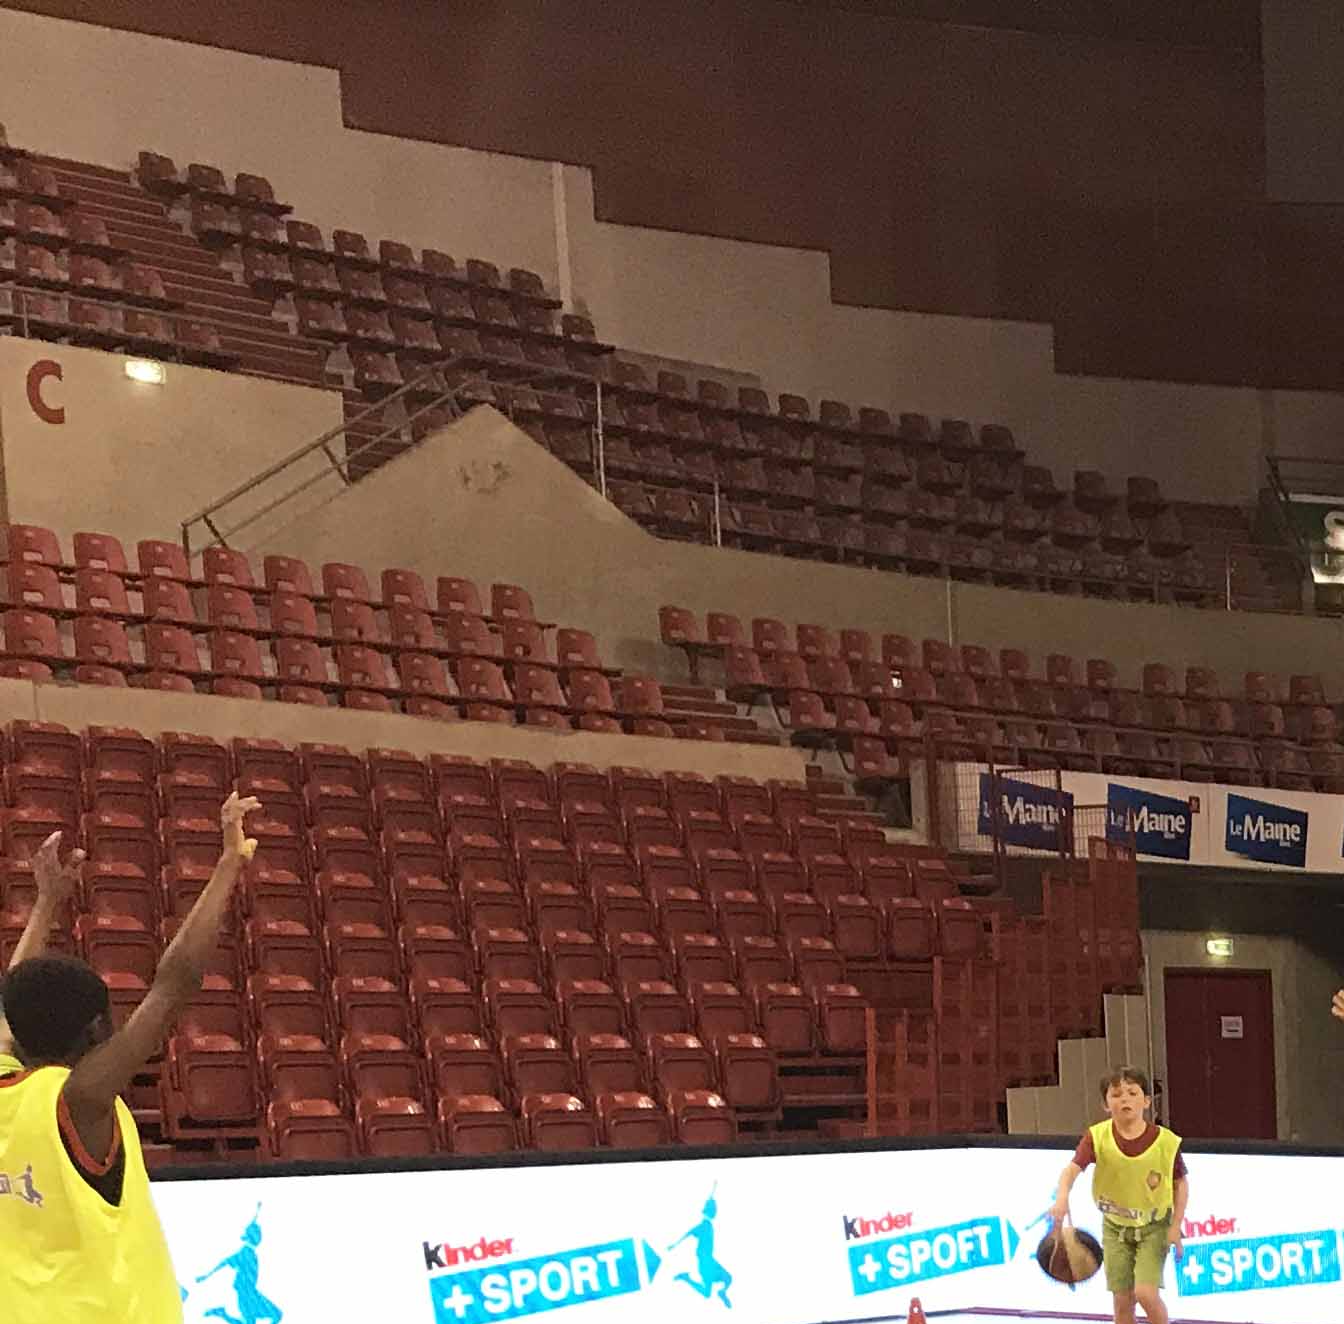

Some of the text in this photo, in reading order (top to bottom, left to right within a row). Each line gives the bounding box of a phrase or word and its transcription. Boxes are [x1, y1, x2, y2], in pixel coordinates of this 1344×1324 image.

[26, 359, 65, 425] C
[1229, 814, 1301, 844] Le Maine
